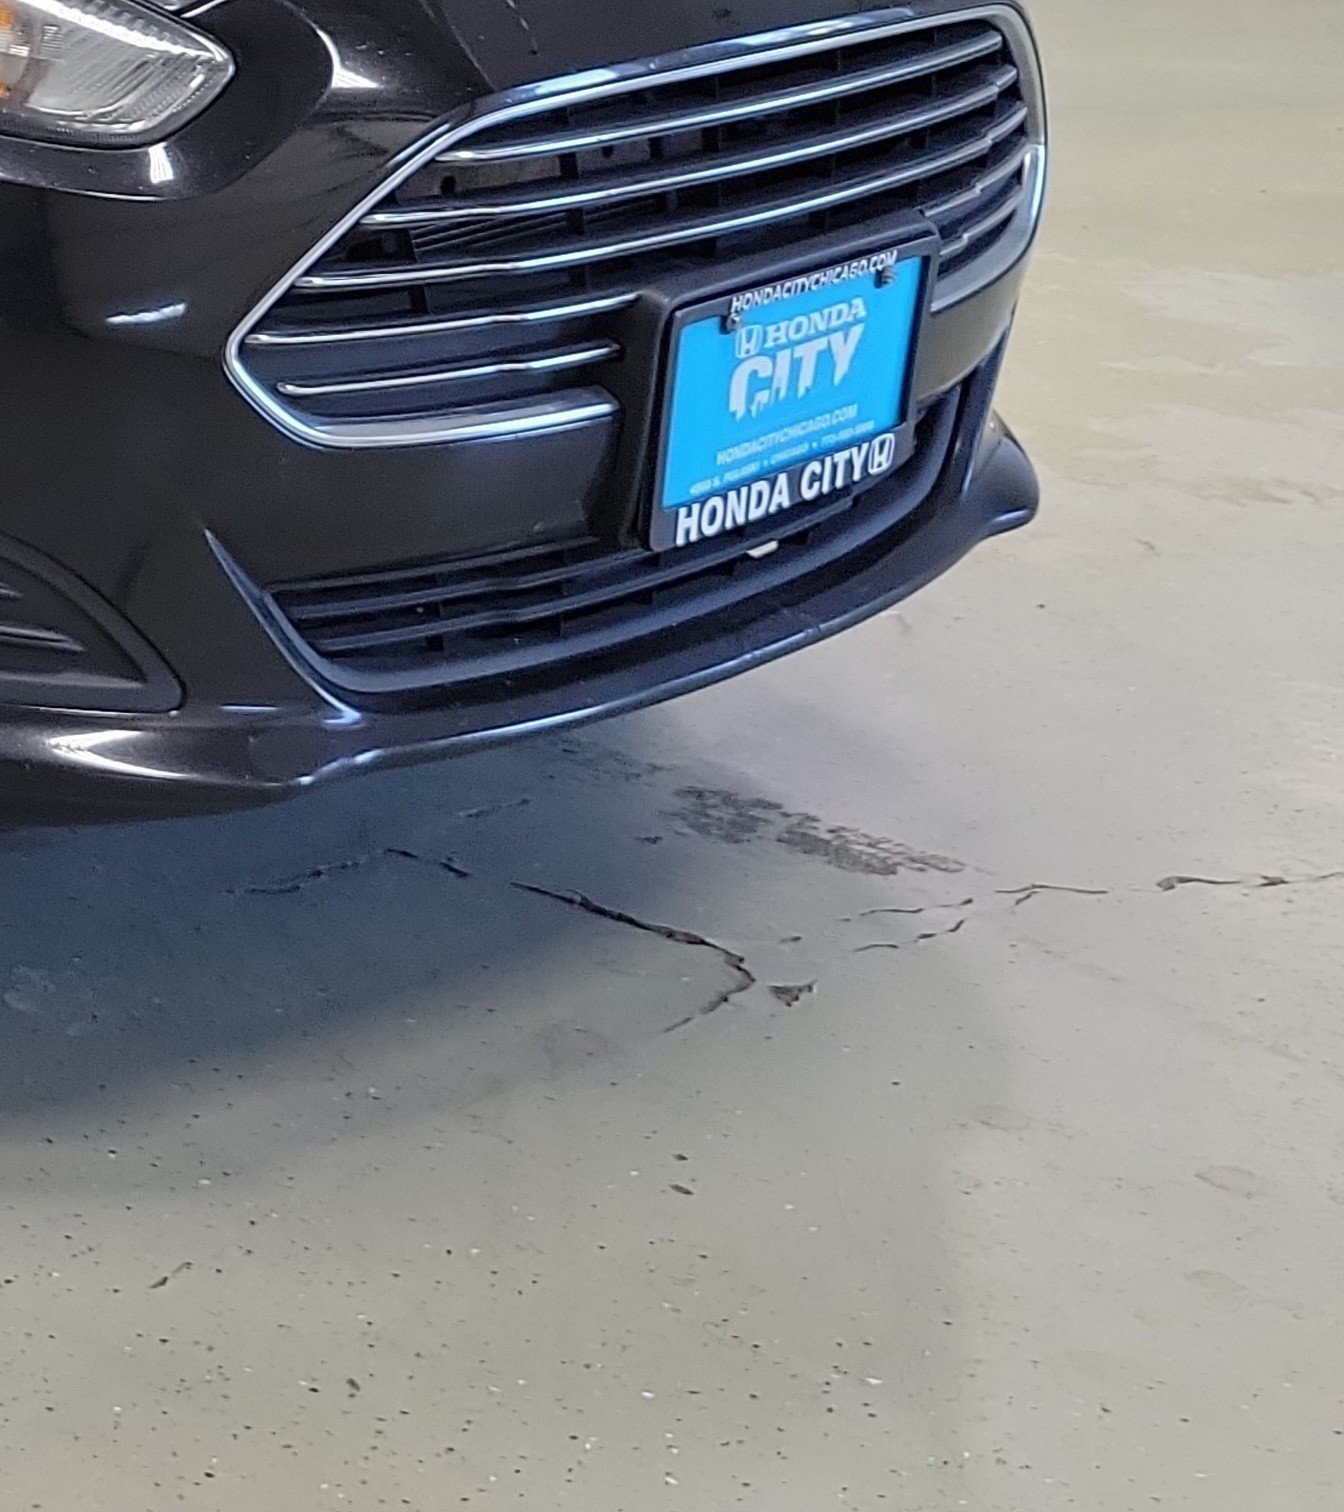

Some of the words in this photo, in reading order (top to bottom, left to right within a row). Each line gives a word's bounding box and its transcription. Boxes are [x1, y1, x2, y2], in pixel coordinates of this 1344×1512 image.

[730, 249, 898, 314] HONDACITYCHICAGO.COM
[762, 296, 867, 348] HONDA
[728, 322, 865, 422] CITY
[675, 472, 791, 547] HONDA
[800, 442, 870, 501] CITY
